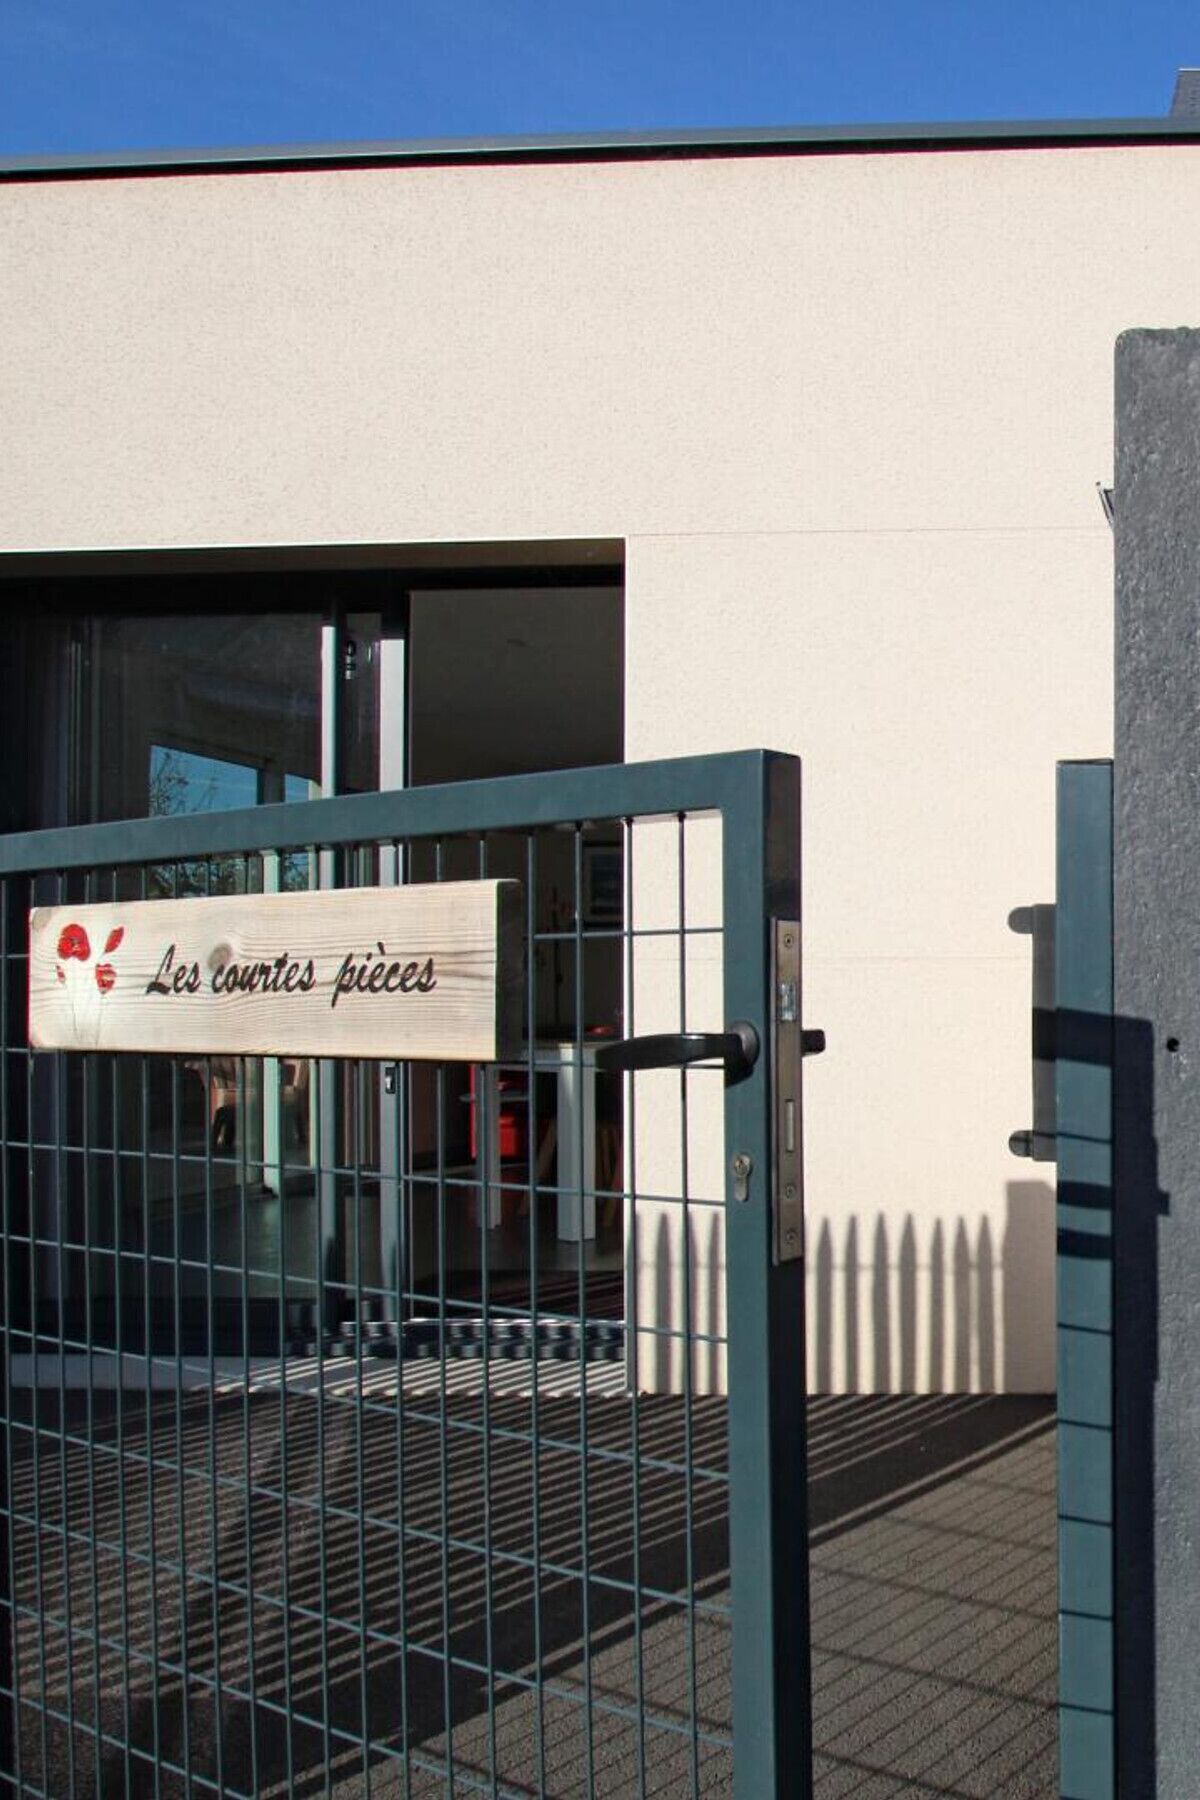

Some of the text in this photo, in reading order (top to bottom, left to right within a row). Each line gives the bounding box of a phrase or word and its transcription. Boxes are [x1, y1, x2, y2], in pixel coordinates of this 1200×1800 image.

[146, 941, 437, 1007] Les courtes pièces
